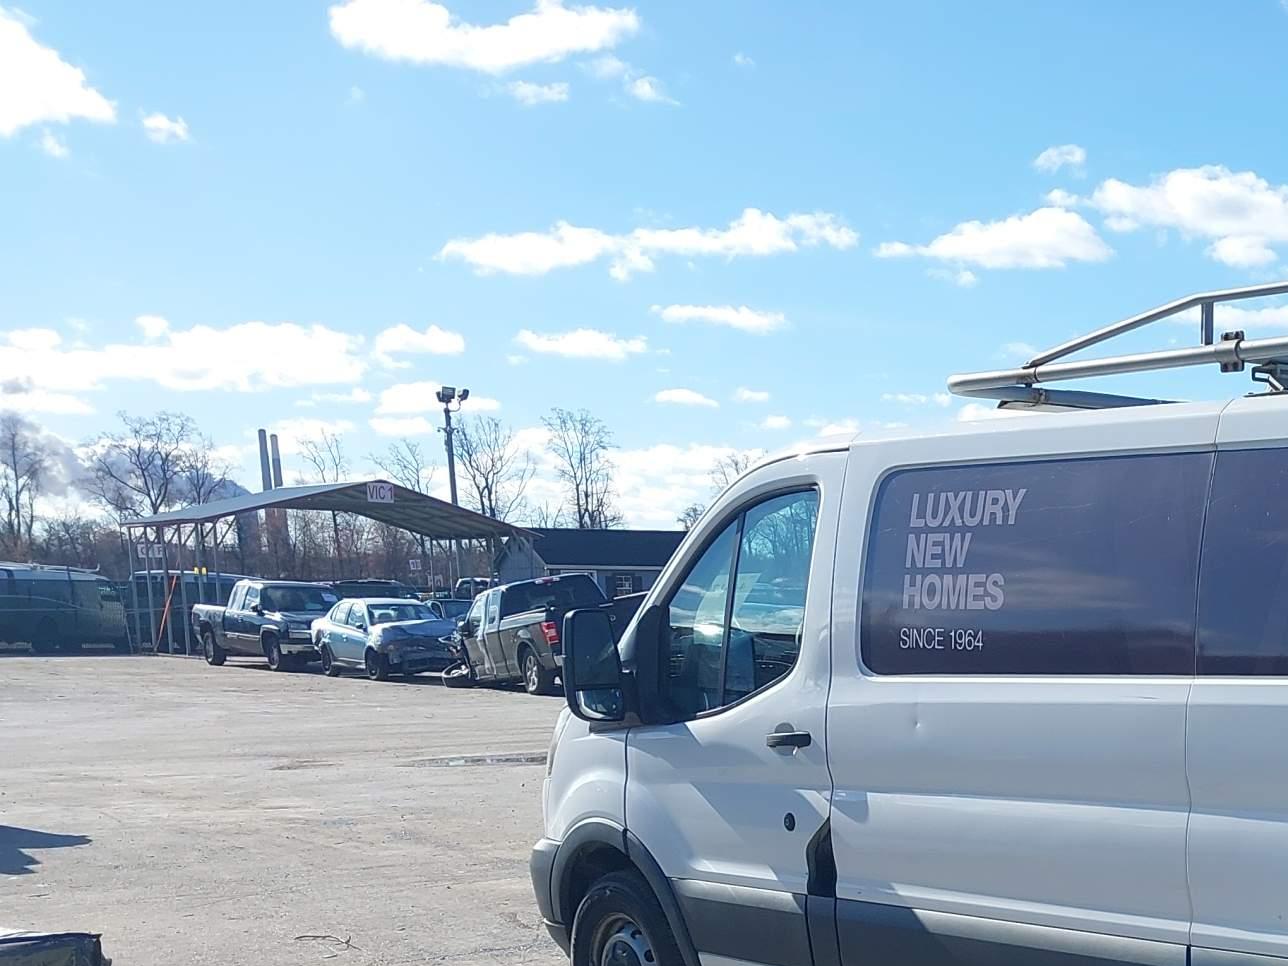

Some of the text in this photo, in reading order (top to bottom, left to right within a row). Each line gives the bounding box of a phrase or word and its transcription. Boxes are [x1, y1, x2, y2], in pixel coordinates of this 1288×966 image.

[367, 485, 386, 500] VIC
[909, 488, 1027, 528] LUXURY
[905, 532, 972, 568] NEW
[902, 573, 1005, 610] HOMES
[900, 628, 983, 650] SINCE 1964
